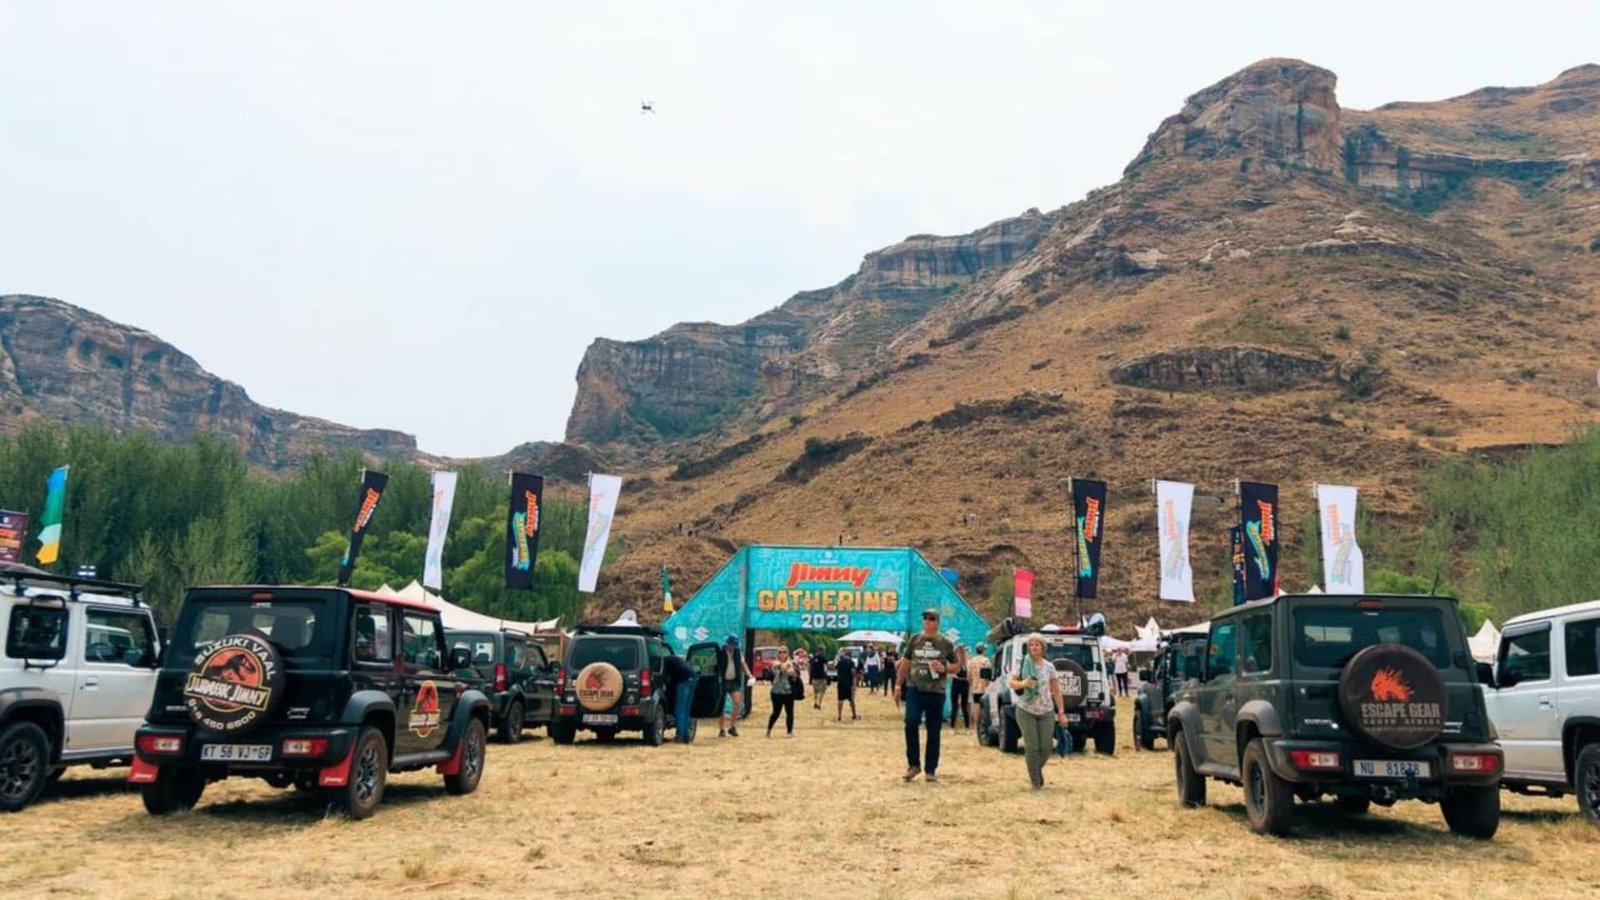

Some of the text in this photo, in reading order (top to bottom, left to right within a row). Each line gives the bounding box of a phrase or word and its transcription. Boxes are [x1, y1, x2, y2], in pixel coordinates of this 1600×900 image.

[757, 589, 898, 612] GATHERING
[801, 613, 849, 629] 2023
[194, 638, 276, 680] SUZUKI VAAL
[229, 684, 268, 706] JIMNY
[1361, 702, 1441, 718] ESCAPE GEAR
[203, 745, 216, 758] KT
[238, 746, 251, 759] VJ
[258, 746, 270, 759] GP
[1360, 762, 1375, 775] NU
